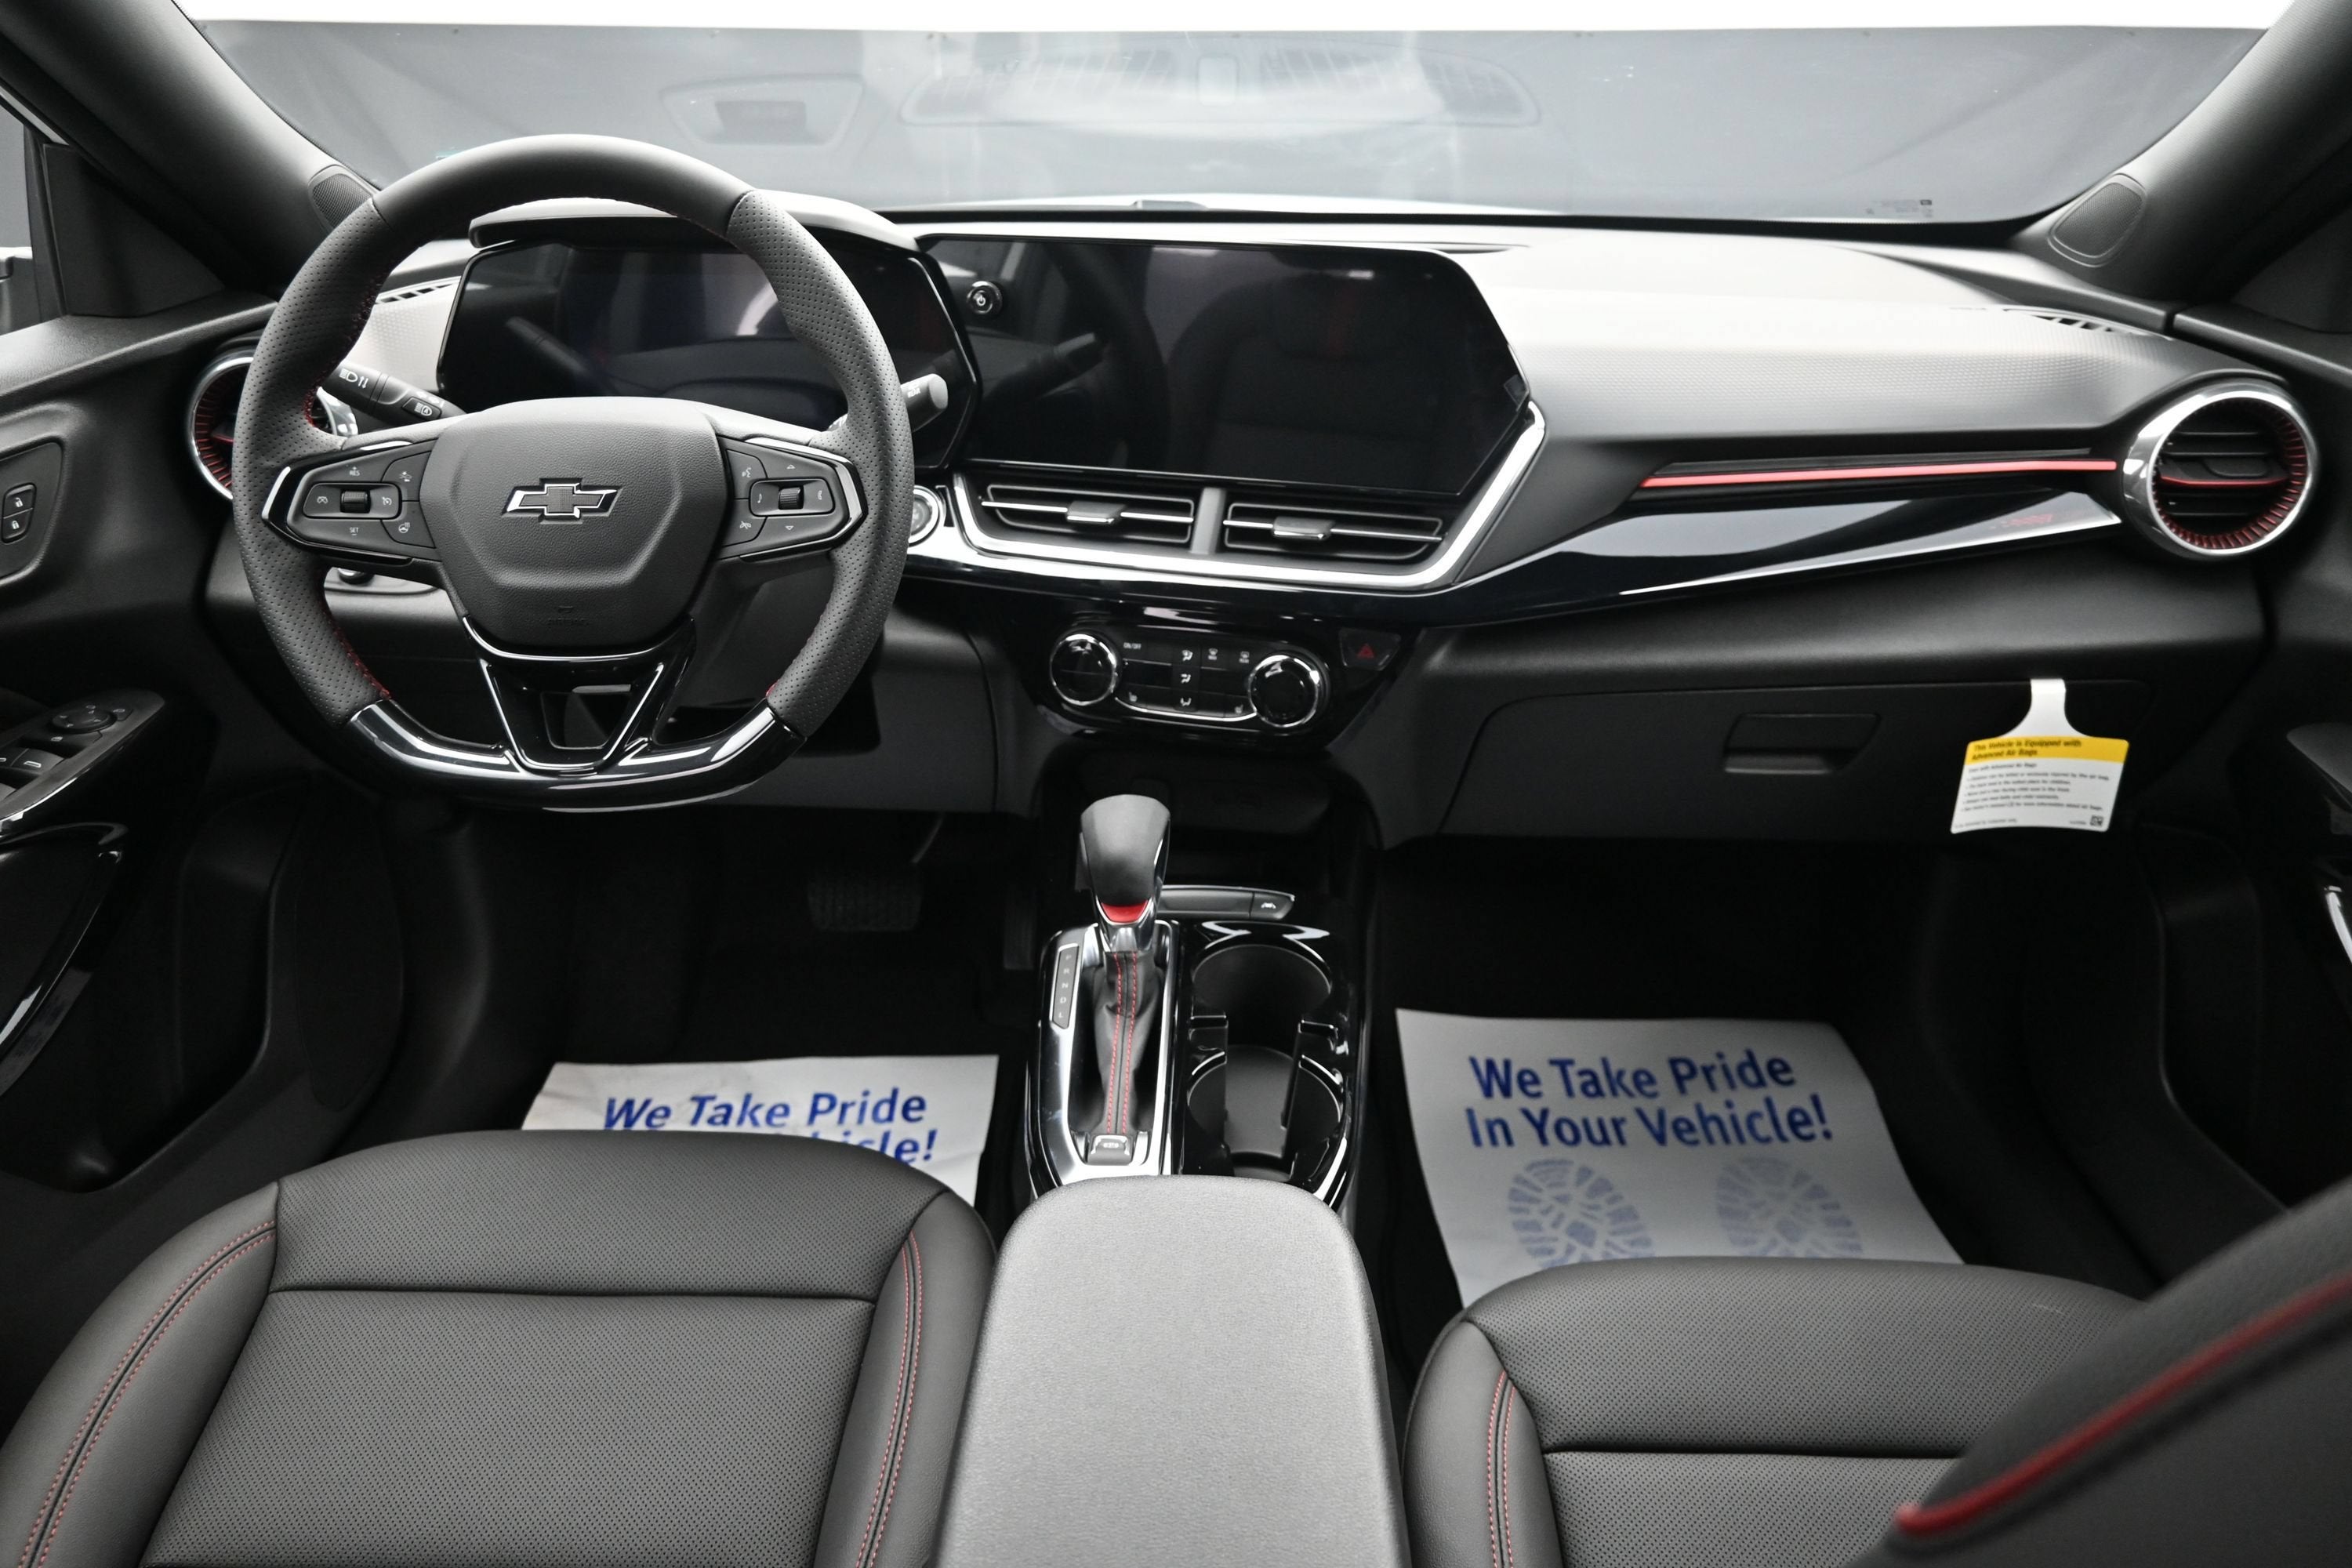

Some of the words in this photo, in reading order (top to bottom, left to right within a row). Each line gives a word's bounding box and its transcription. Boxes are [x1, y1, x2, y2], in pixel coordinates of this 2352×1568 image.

[1971, 750, 2004, 760] Advanced
[2018, 749, 2038, 757] Bags
[2024, 739, 2062, 748] Equipped
[1468, 1055, 1543, 1099] We
[1548, 1056, 1660, 1099] Take
[1668, 1047, 1796, 1096] Pride
[604, 1098, 672, 1130] We
[690, 1093, 791, 1128] Take
[808, 1087, 928, 1127] Pride
[1465, 1106, 1515, 1148] In
[1519, 1106, 1628, 1147] Your
[1635, 1093, 1833, 1148] Vehicle!
